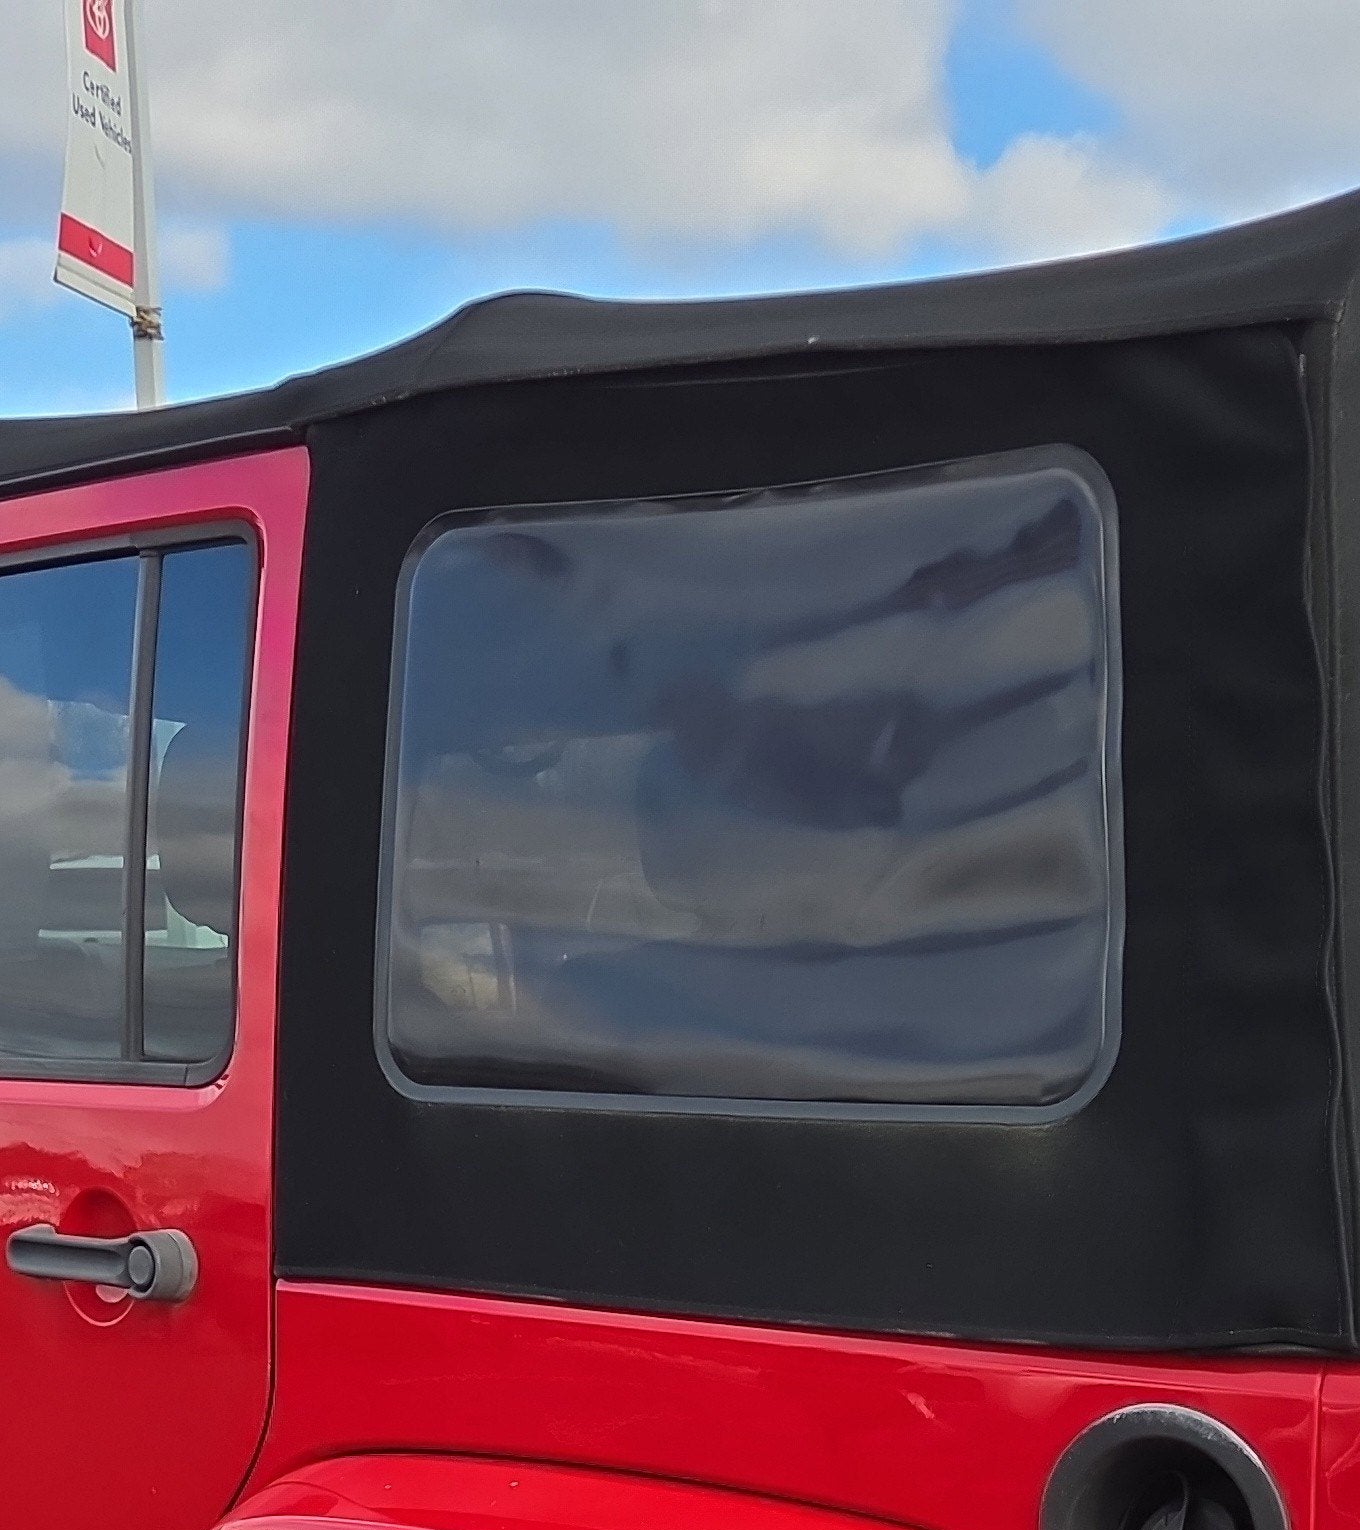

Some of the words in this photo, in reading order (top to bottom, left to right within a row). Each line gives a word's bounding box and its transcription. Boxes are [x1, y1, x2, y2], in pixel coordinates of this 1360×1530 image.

[83, 71, 121, 116] Certified
[72, 92, 96, 127] Used
[99, 110, 132, 154] Vehicles
